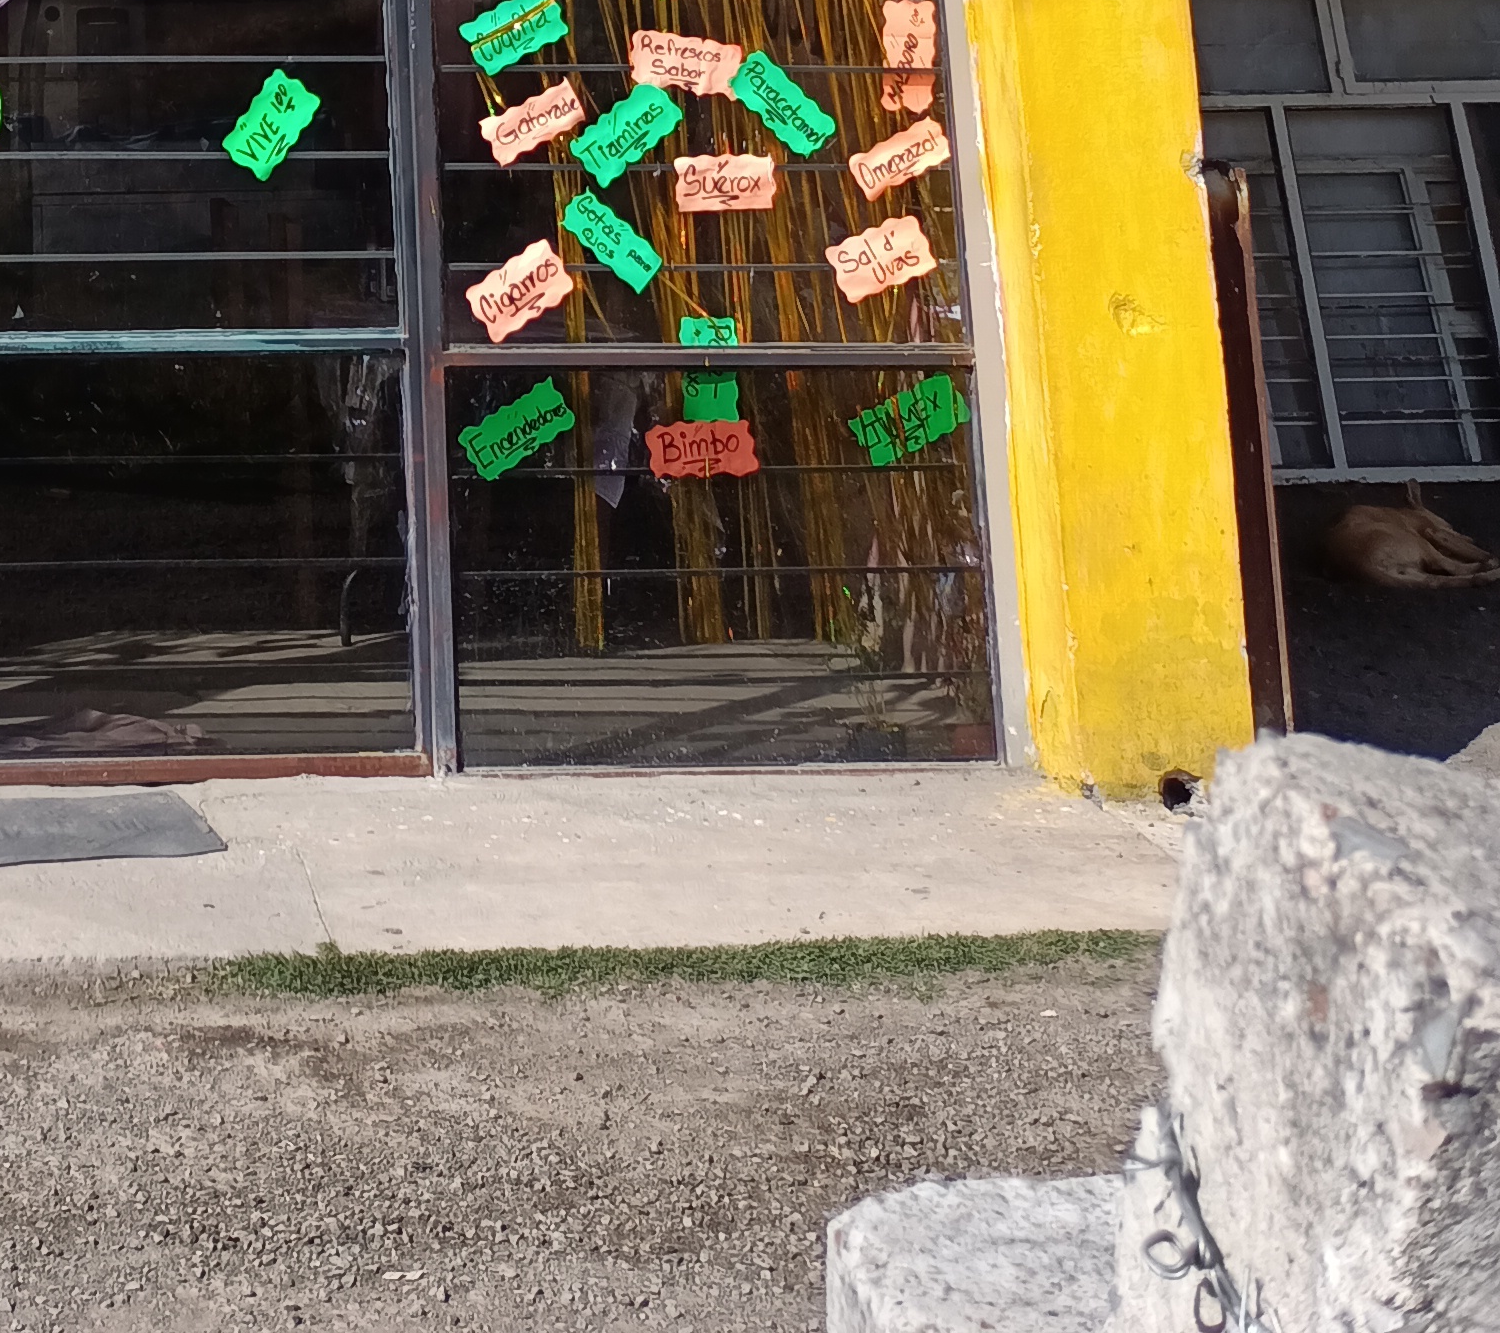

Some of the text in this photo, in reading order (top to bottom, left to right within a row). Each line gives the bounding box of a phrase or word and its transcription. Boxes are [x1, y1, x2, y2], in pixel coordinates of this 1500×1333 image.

[640, 34, 721, 63] Refrescos
[650, 59, 706, 79] Sabor
[236, 113, 280, 161] VIVE
[496, 96, 579, 146] Gatorade
[858, 130, 939, 190] Omeprazol
[683, 164, 761, 197] Suerox
[577, 196, 622, 246] Gotas
[837, 238, 878, 274] Sal
[872, 250, 920, 284] Uvas
[479, 259, 558, 323] Cigarros
[657, 430, 739, 464] Bimbo
